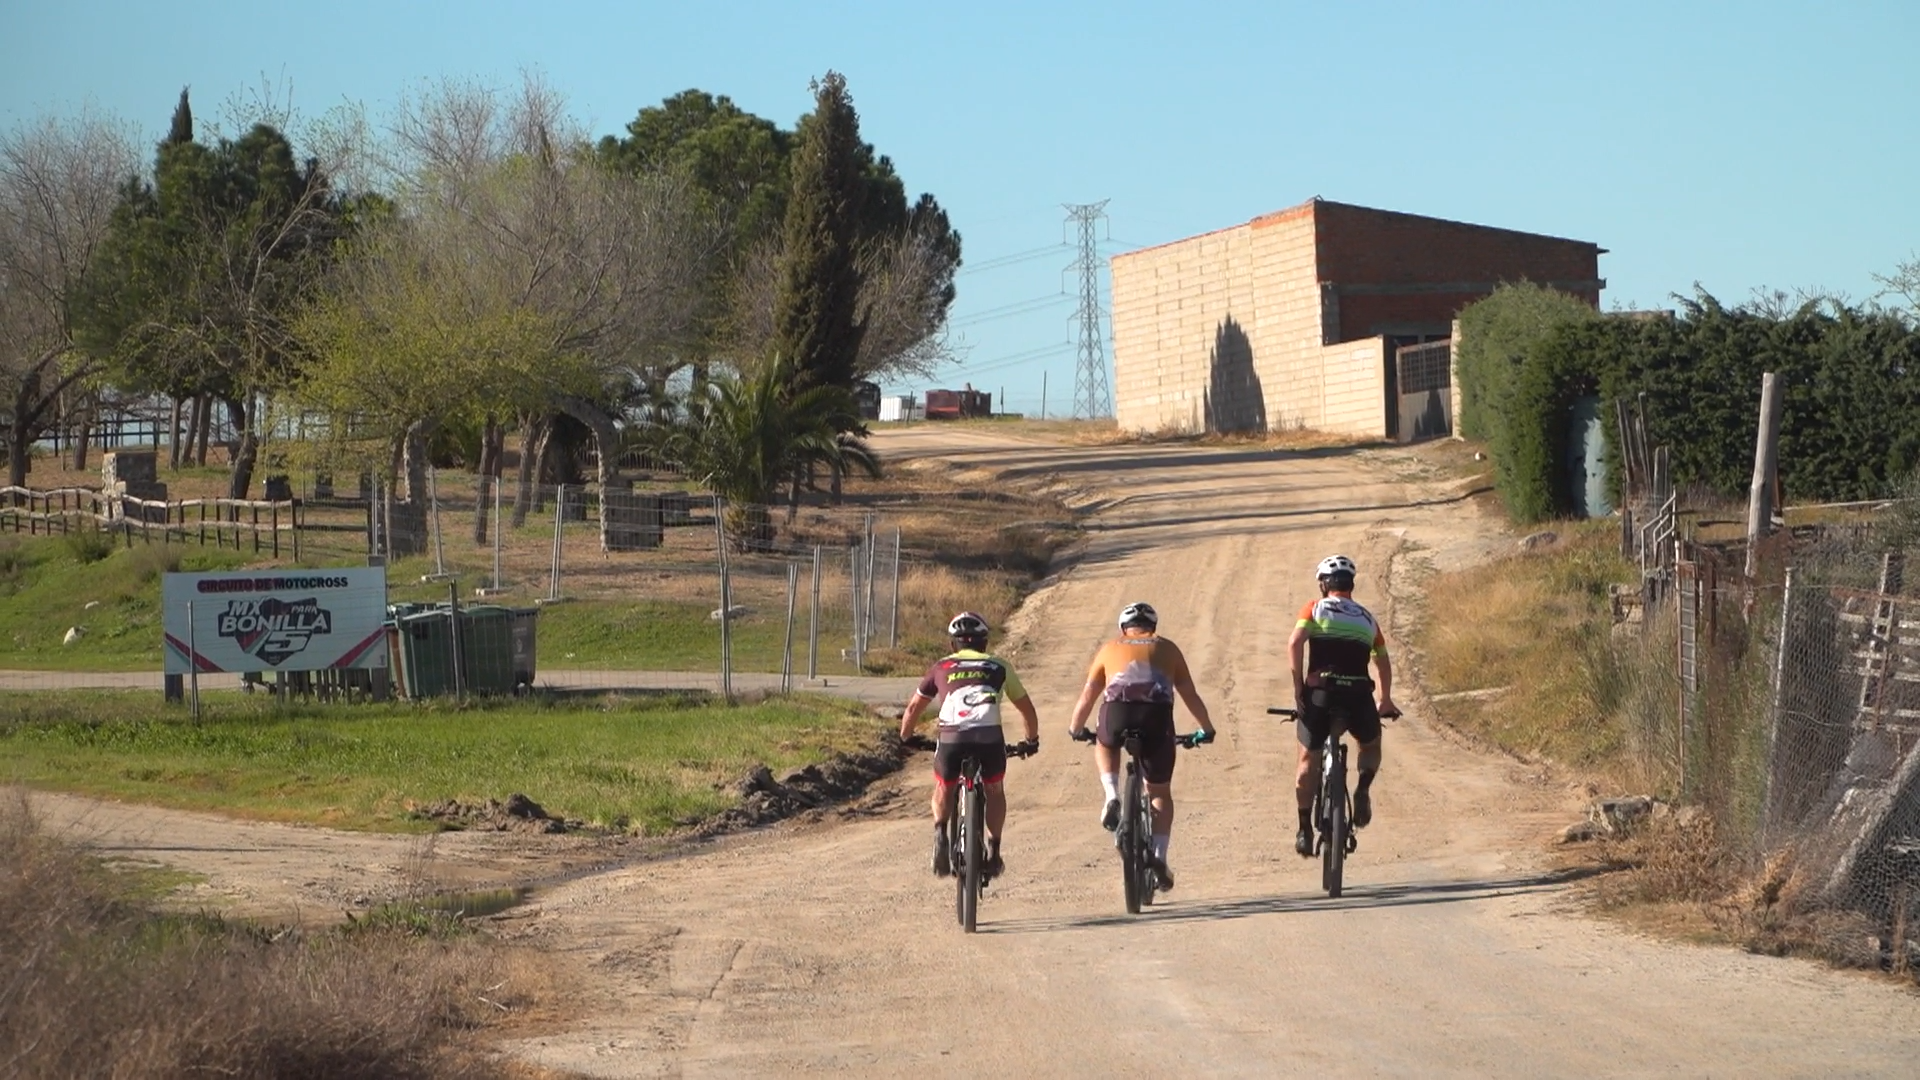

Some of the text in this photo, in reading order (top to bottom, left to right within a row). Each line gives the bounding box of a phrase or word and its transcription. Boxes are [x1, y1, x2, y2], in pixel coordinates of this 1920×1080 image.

[197, 576, 348, 593] CIRCUITO DE MOTOCROSS
[229, 600, 263, 616] MX
[221, 612, 328, 632] BONILLA
[264, 631, 310, 652] 5
